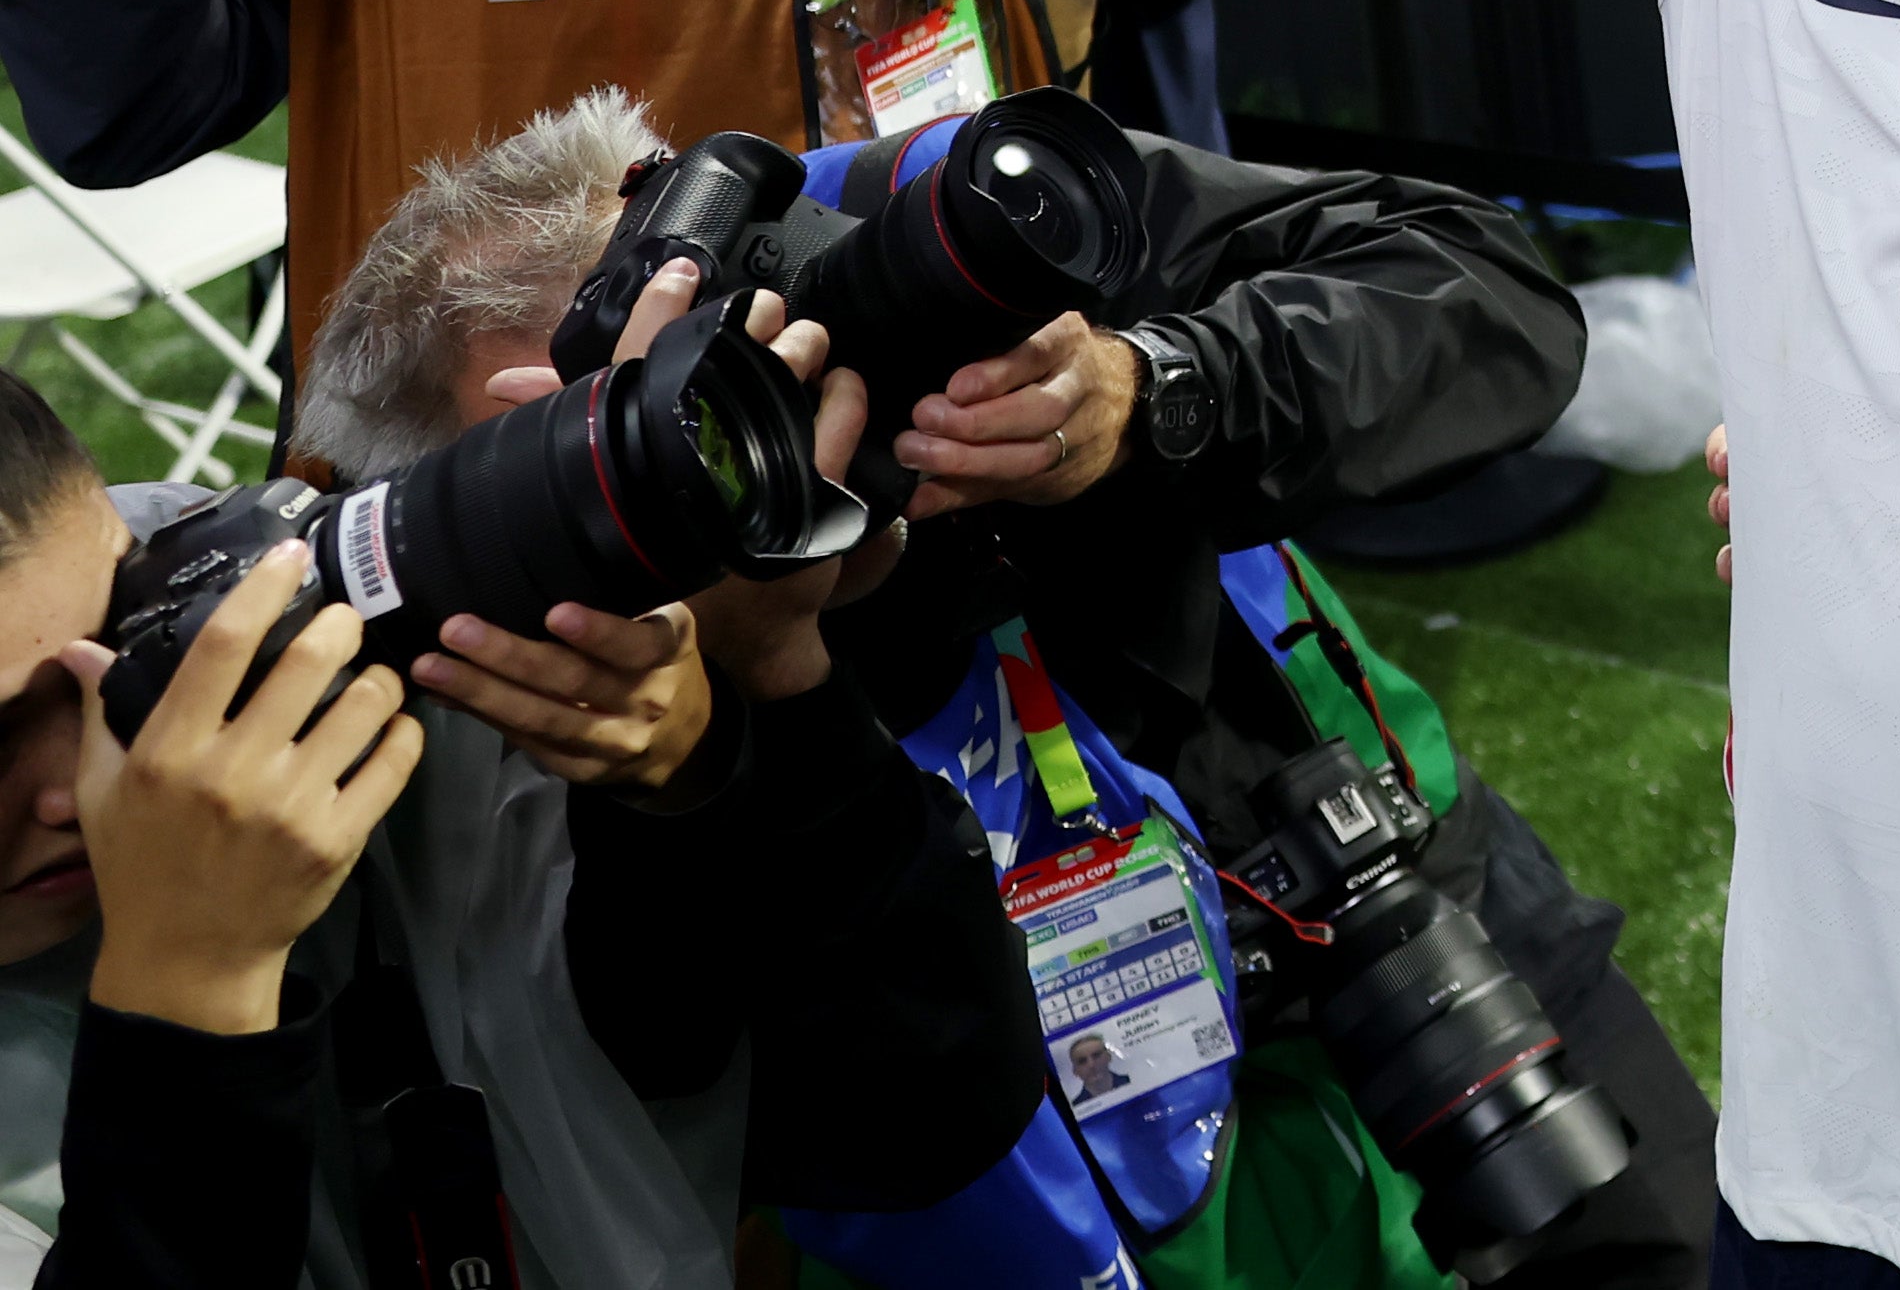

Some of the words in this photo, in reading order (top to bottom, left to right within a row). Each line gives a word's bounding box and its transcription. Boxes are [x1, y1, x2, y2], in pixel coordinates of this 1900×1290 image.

[1037, 873, 1085, 899] WORLD
[1085, 862, 1113, 880] CUP
[1346, 854, 1397, 890] Canon
[1036, 979, 1065, 996] FIFA
[1066, 960, 1107, 984] STAFF
